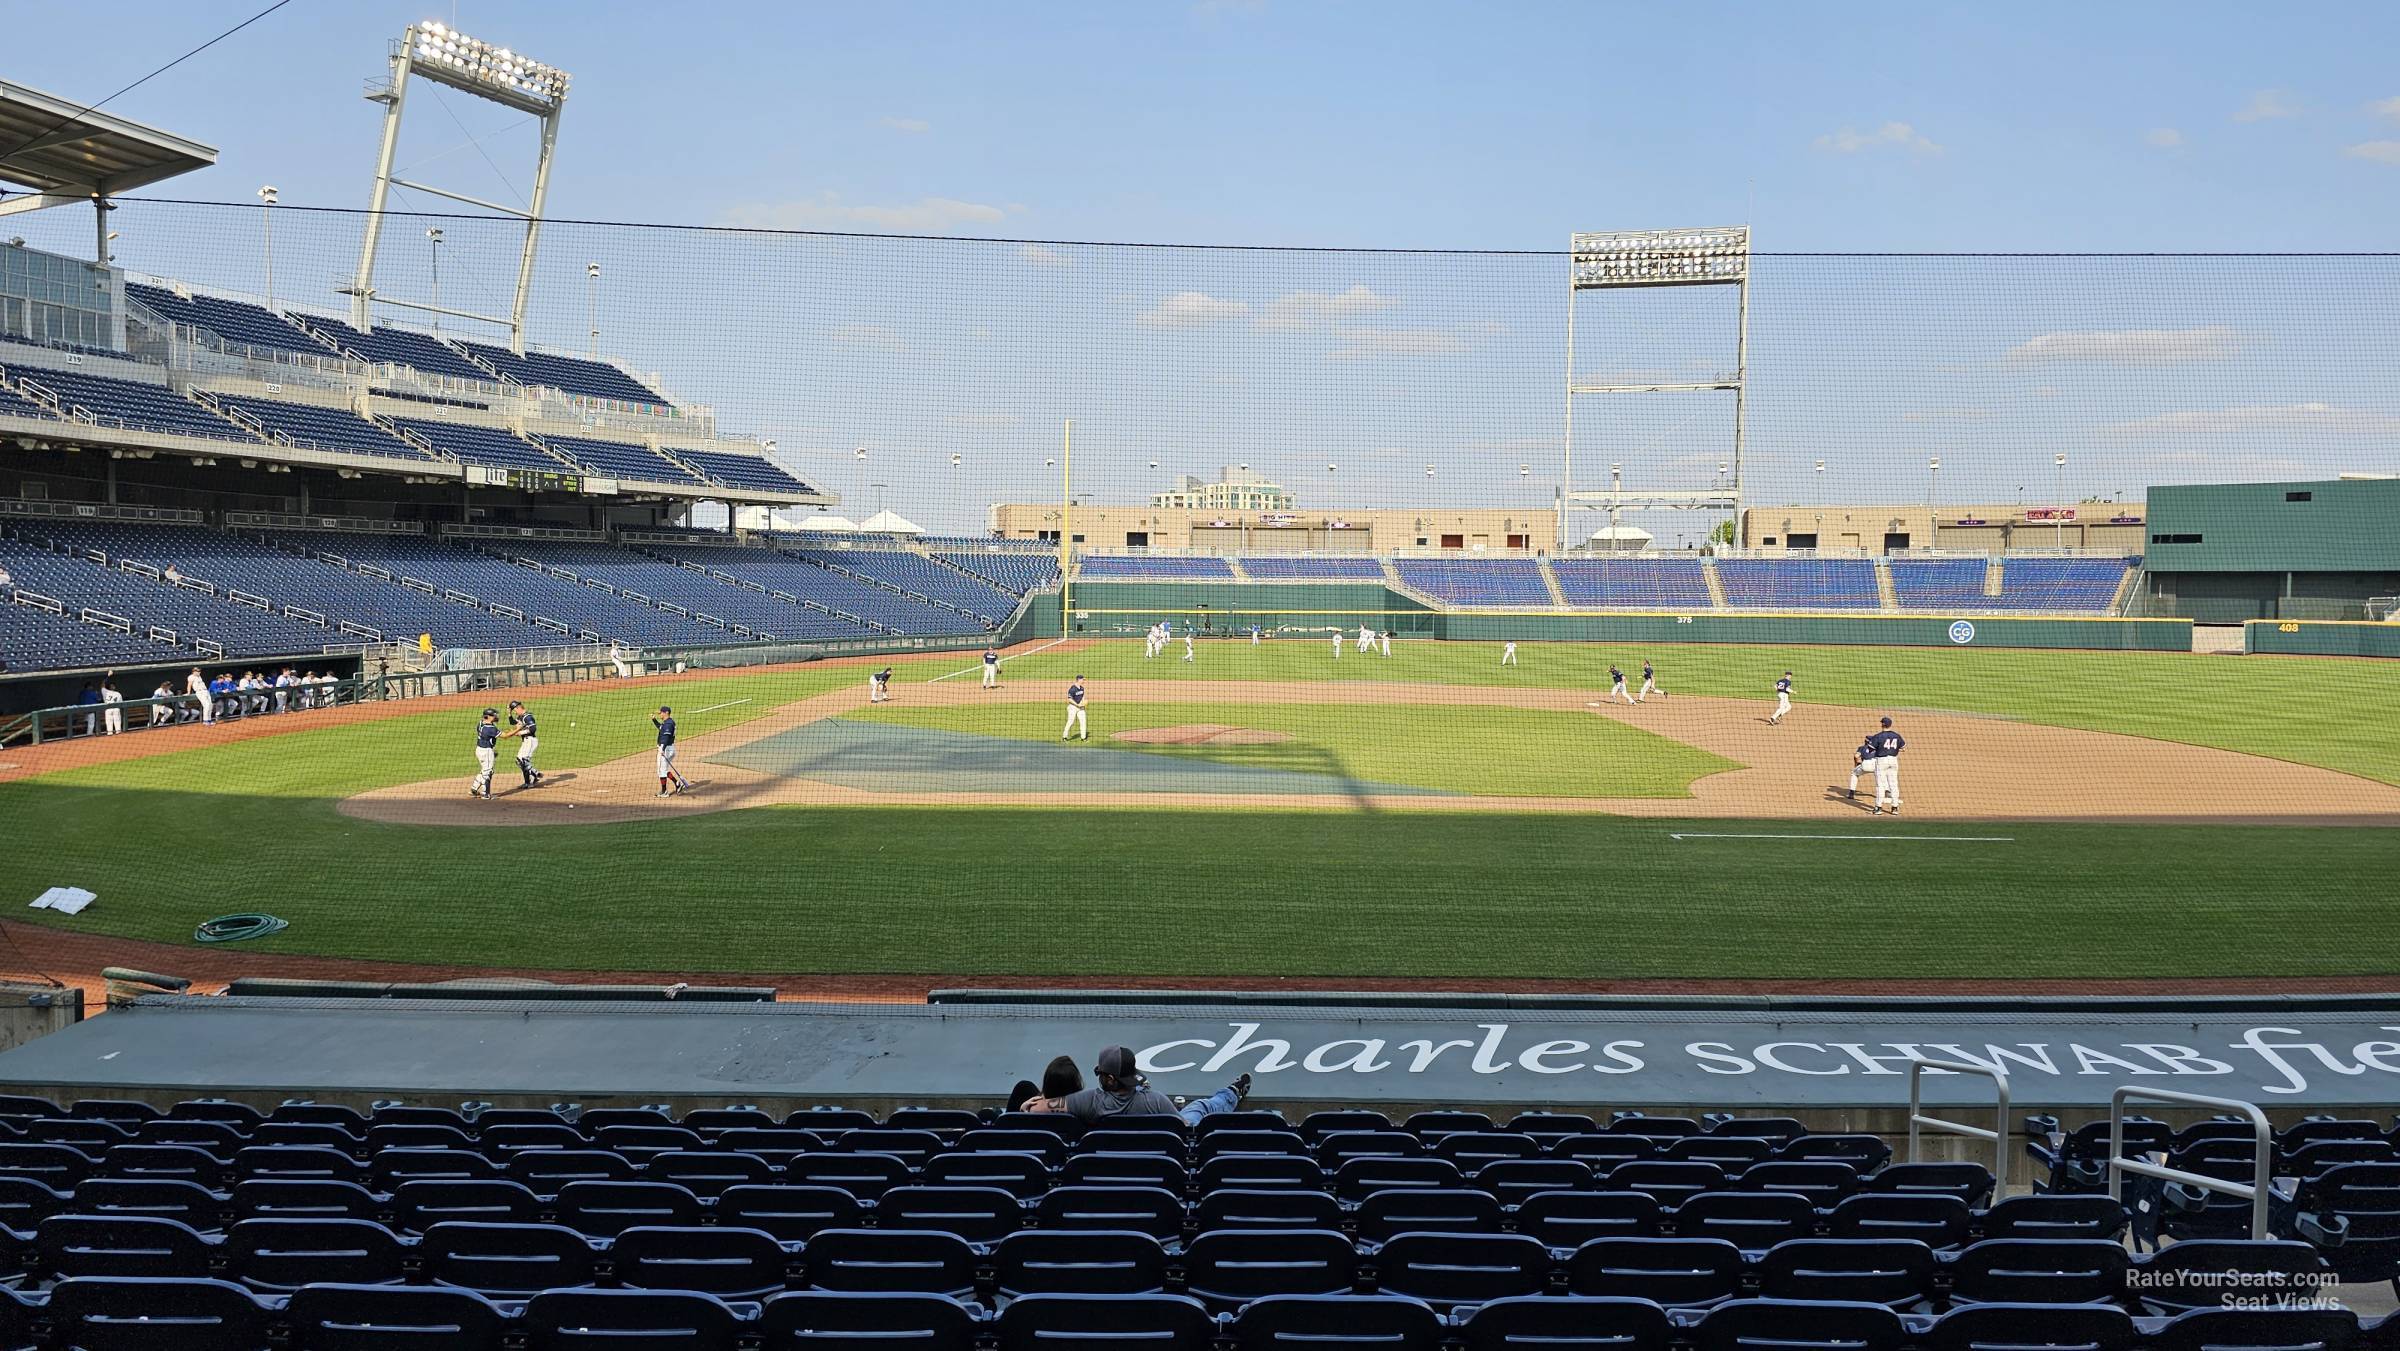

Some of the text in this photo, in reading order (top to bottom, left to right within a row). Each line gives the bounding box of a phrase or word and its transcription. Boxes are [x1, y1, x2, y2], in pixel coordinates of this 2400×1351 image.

[68, 355, 82, 363] 219
[1677, 616, 1693, 624] 375
[2278, 623, 2299, 632] 408
[1883, 738, 1898, 750] 44
[1135, 1023, 2400, 1094] charles SCHWAB fie
